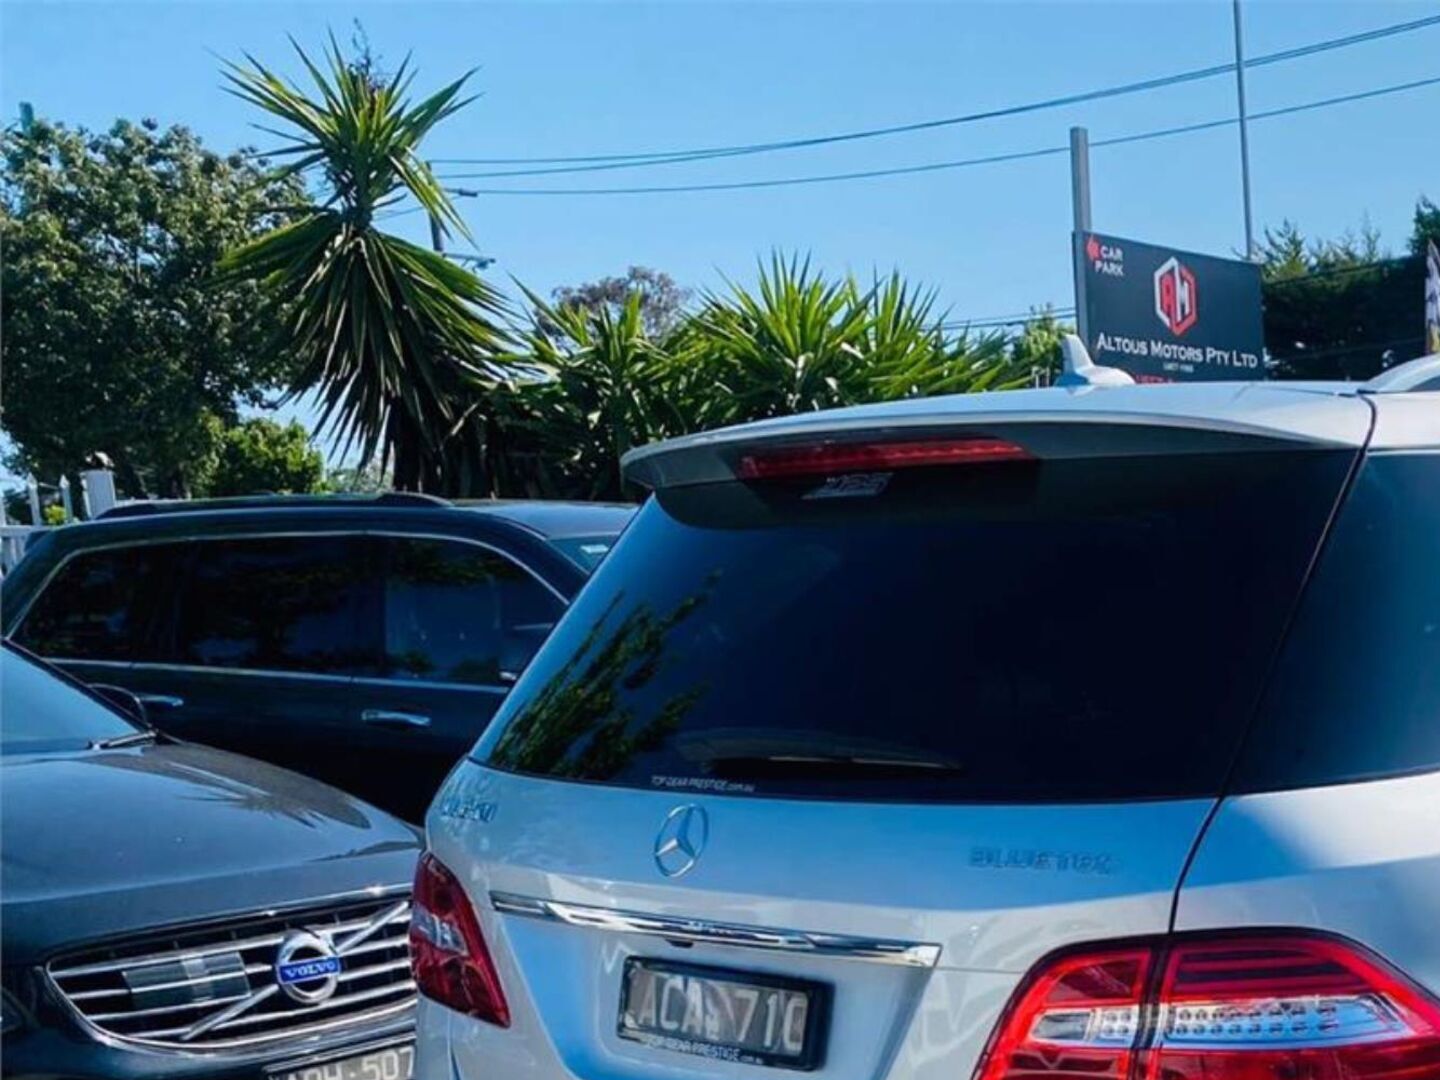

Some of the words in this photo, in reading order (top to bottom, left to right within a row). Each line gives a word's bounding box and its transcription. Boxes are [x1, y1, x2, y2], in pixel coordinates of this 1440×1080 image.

[1100, 245, 1123, 261] CAR
[1095, 260, 1124, 277] PARK
[1097, 332, 1148, 356] ALTOUS
[1150, 340, 1203, 362] MOTORS
[1206, 347, 1230, 366] PTY
[1232, 349, 1258, 369] LTD
[284, 960, 335, 978] VOLVO
